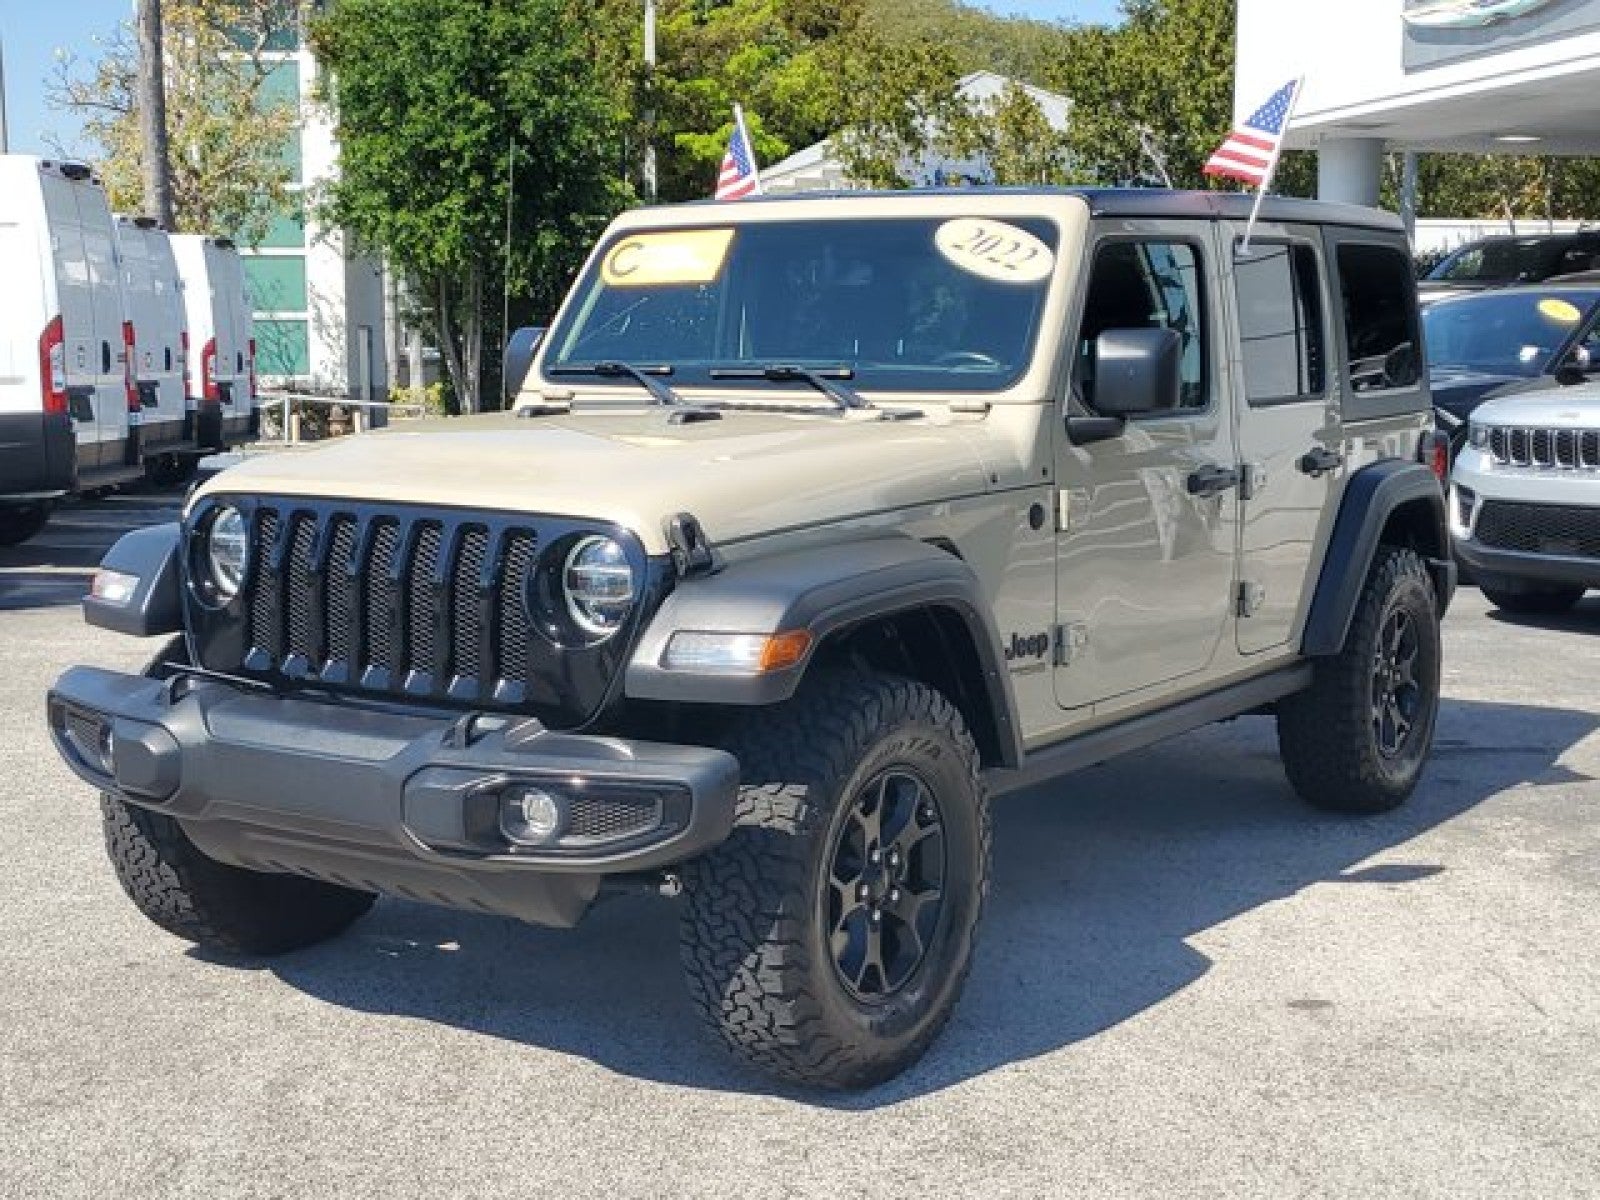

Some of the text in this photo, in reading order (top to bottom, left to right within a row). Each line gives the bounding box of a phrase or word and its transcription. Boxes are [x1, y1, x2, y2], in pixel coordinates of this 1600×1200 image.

[609, 241, 645, 278] C
[951, 227, 1040, 271] 2022
[1005, 631, 1048, 661] Jeep
